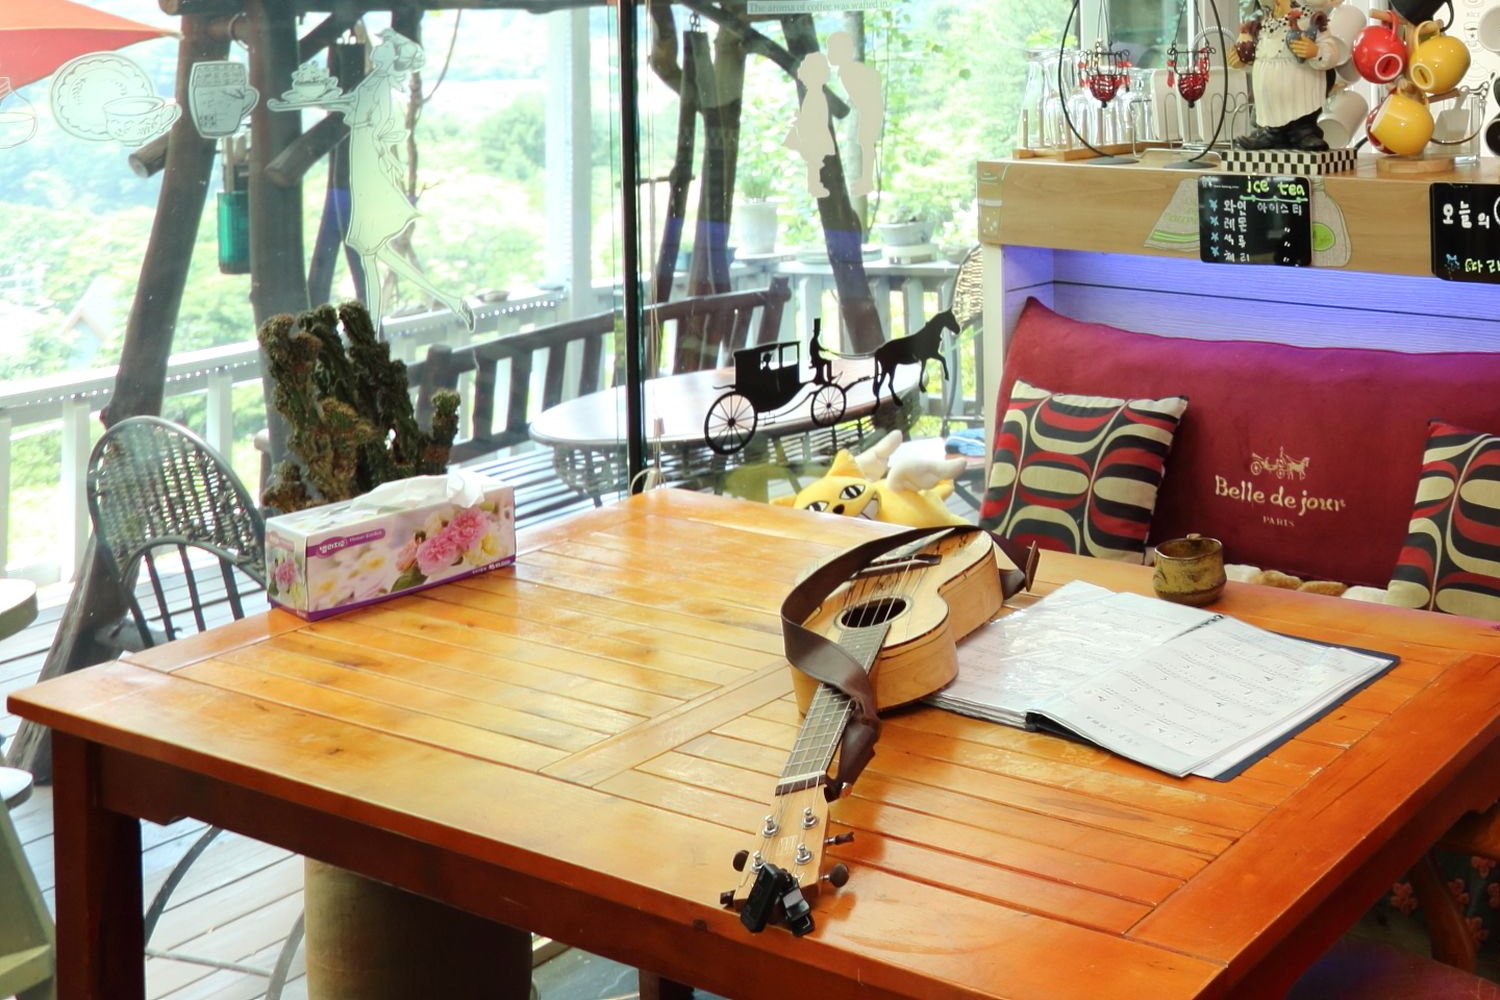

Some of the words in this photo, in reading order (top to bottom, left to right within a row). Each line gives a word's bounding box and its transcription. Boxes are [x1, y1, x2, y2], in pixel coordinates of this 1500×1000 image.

[1247, 175, 1270, 194] ice
[1277, 181, 1305, 196] tea
[1223, 199, 1247, 217] 와인
[1442, 200, 1491, 229] 오늘의
[1223, 217, 1247, 233] 레몬
[1223, 250, 1250, 263] 체리
[1215, 474, 1265, 504] Belle
[1270, 486, 1297, 508] de
[1298, 490, 1347, 516] jour
[1263, 515, 1295, 527] PARIS
